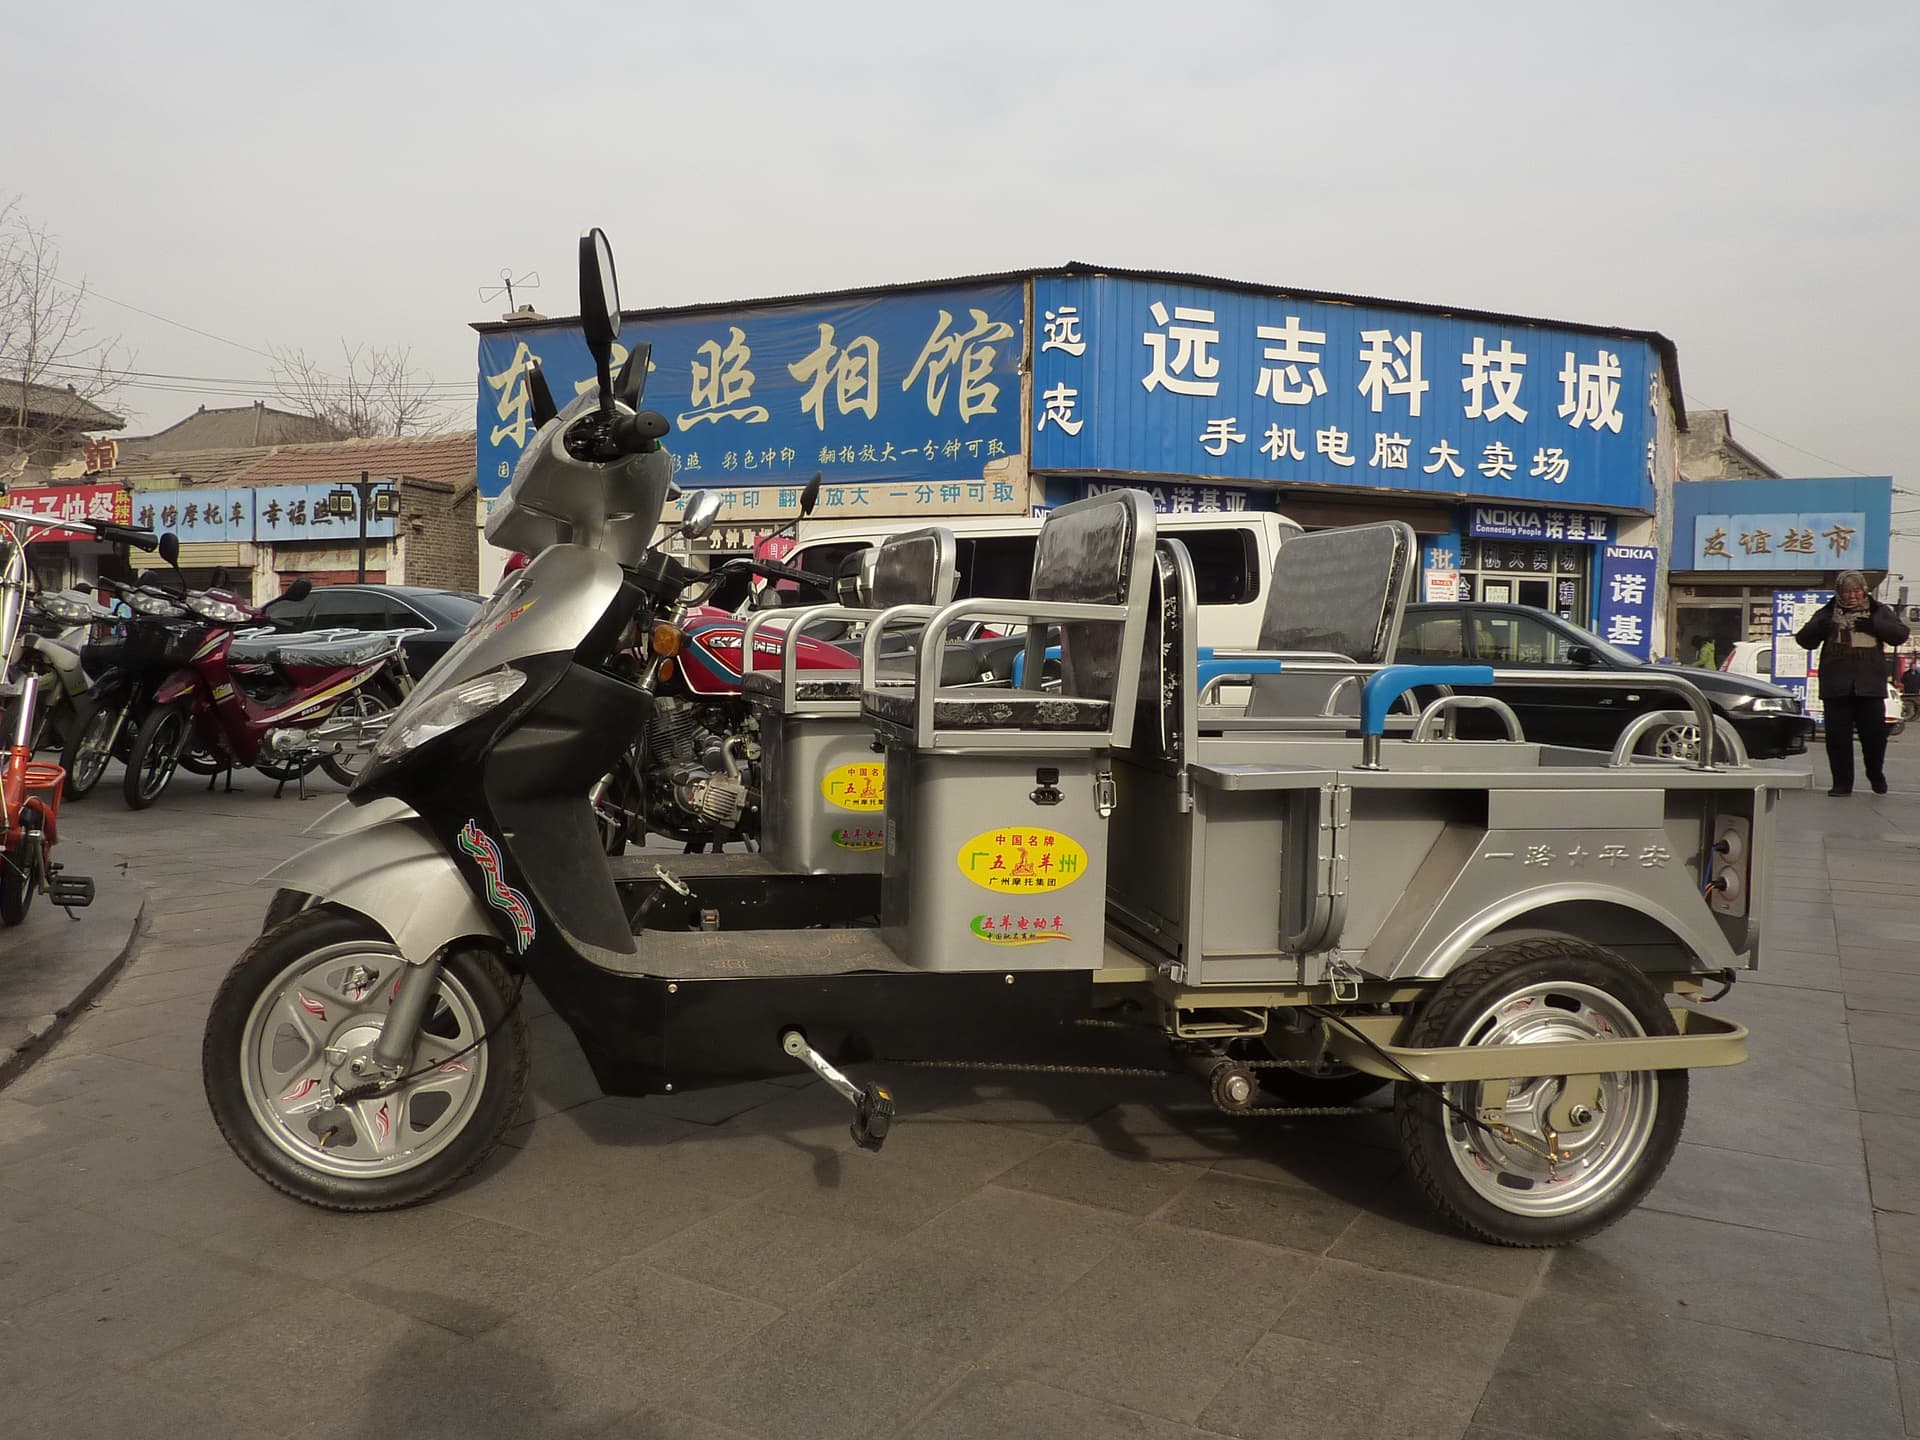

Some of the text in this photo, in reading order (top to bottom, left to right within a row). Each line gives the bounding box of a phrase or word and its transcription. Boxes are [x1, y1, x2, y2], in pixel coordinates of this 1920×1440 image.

[1038, 306, 1086, 436] 远志
[1141, 301, 1625, 434] 远志科技城
[721, 447, 796, 471] 彩色冲印
[817, 439, 1007, 465] 翻拍放大一分钟可取
[1199, 417, 1570, 484] 手机电脑大卖场
[115, 490, 130, 525] 麻辣
[675, 482, 1015, 511] 彩冲印 翻放大 一分钟可取
[1171, 487, 1248, 513] 诺基亚
[1476, 508, 1542, 528] NOKIA
[1476, 525, 1542, 537] Connecting People
[1545, 512, 1608, 541] 诺基亚
[1607, 547, 1654, 560] NOKIA
[1704, 523, 1856, 559] 友谊超市
[1608, 573, 1647, 646] 诺基
[848, 768, 885, 777] 中国名
[995, 834, 1055, 847] 中国名牌
[989, 877, 1057, 887] 广州摩托集团
[982, 914, 1063, 931] 五羊电动车
